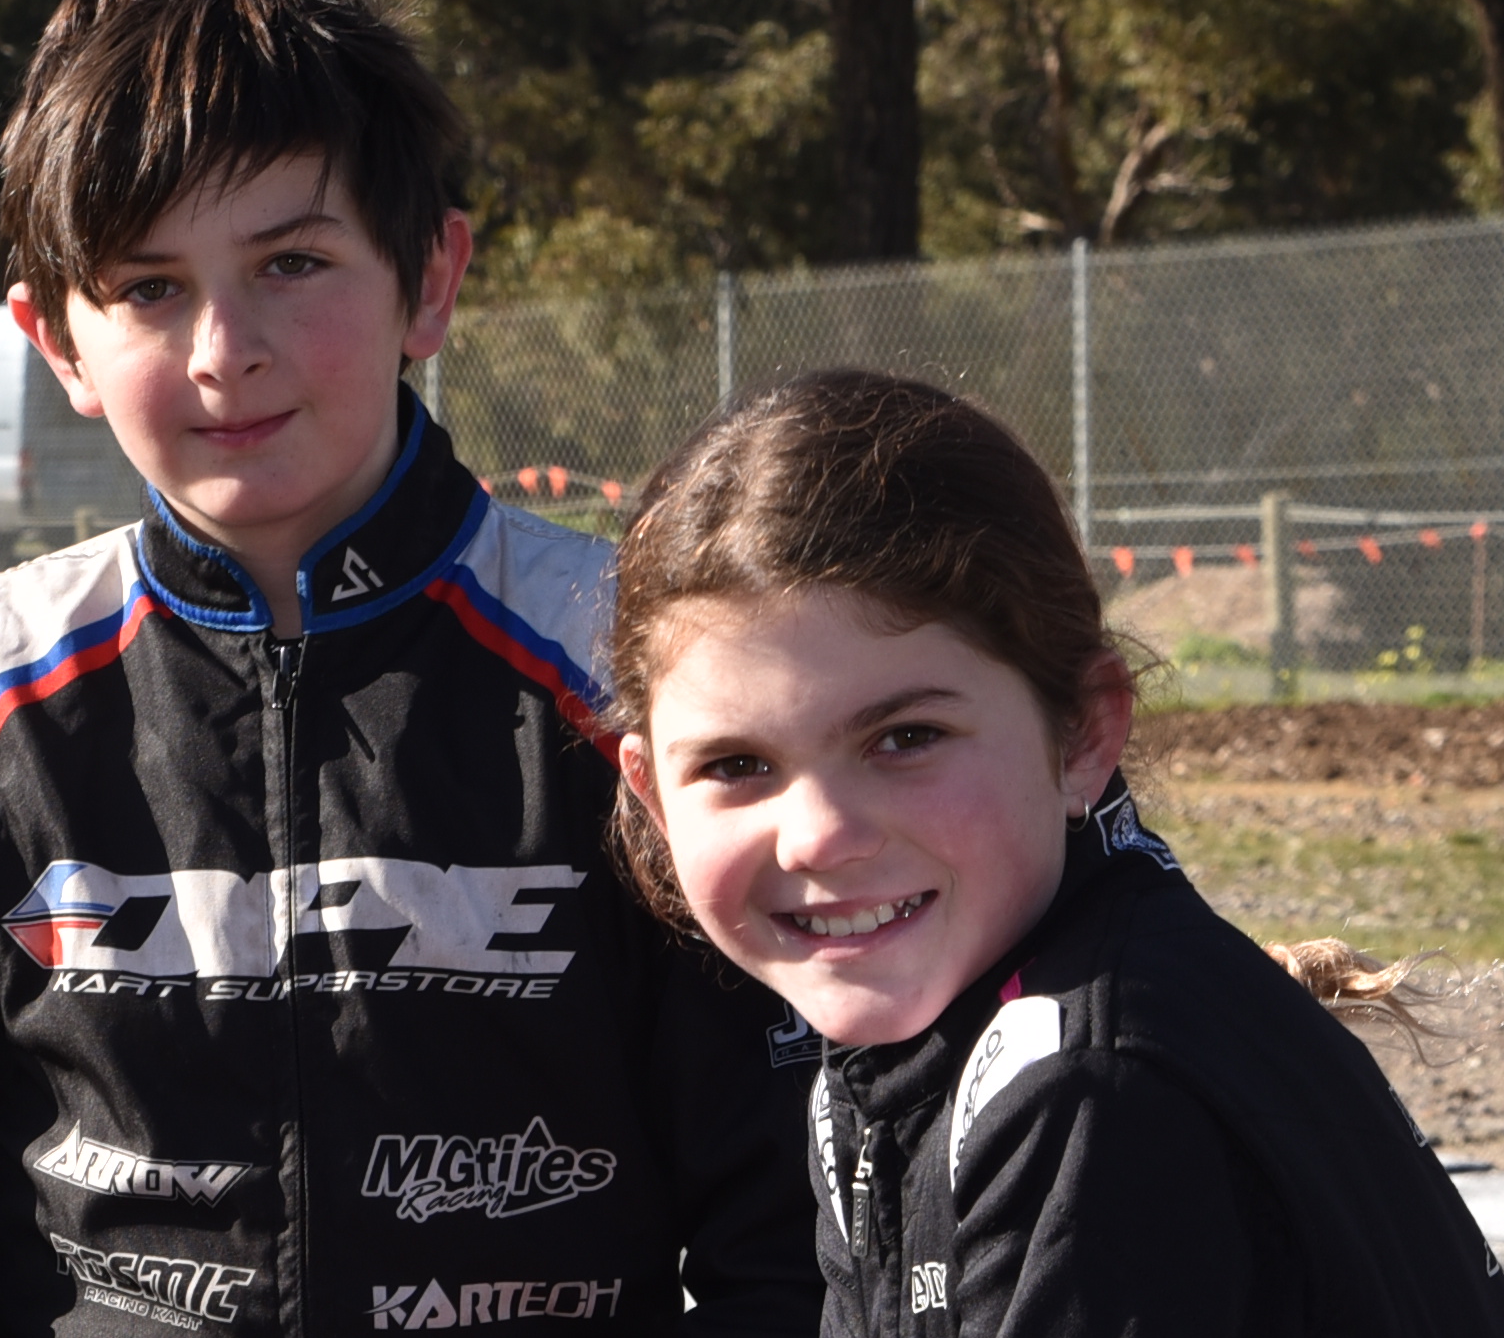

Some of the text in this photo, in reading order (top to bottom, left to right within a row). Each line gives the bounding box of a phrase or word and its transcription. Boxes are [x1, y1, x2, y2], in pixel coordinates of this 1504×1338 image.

[51, 970, 561, 1002] KART SUPERSTORE
[33, 1119, 254, 1209] ARROW
[396, 1179, 509, 1223] Racing
[84, 1285, 203, 1331] RACING KART
[364, 1277, 623, 1331] KARTECH
